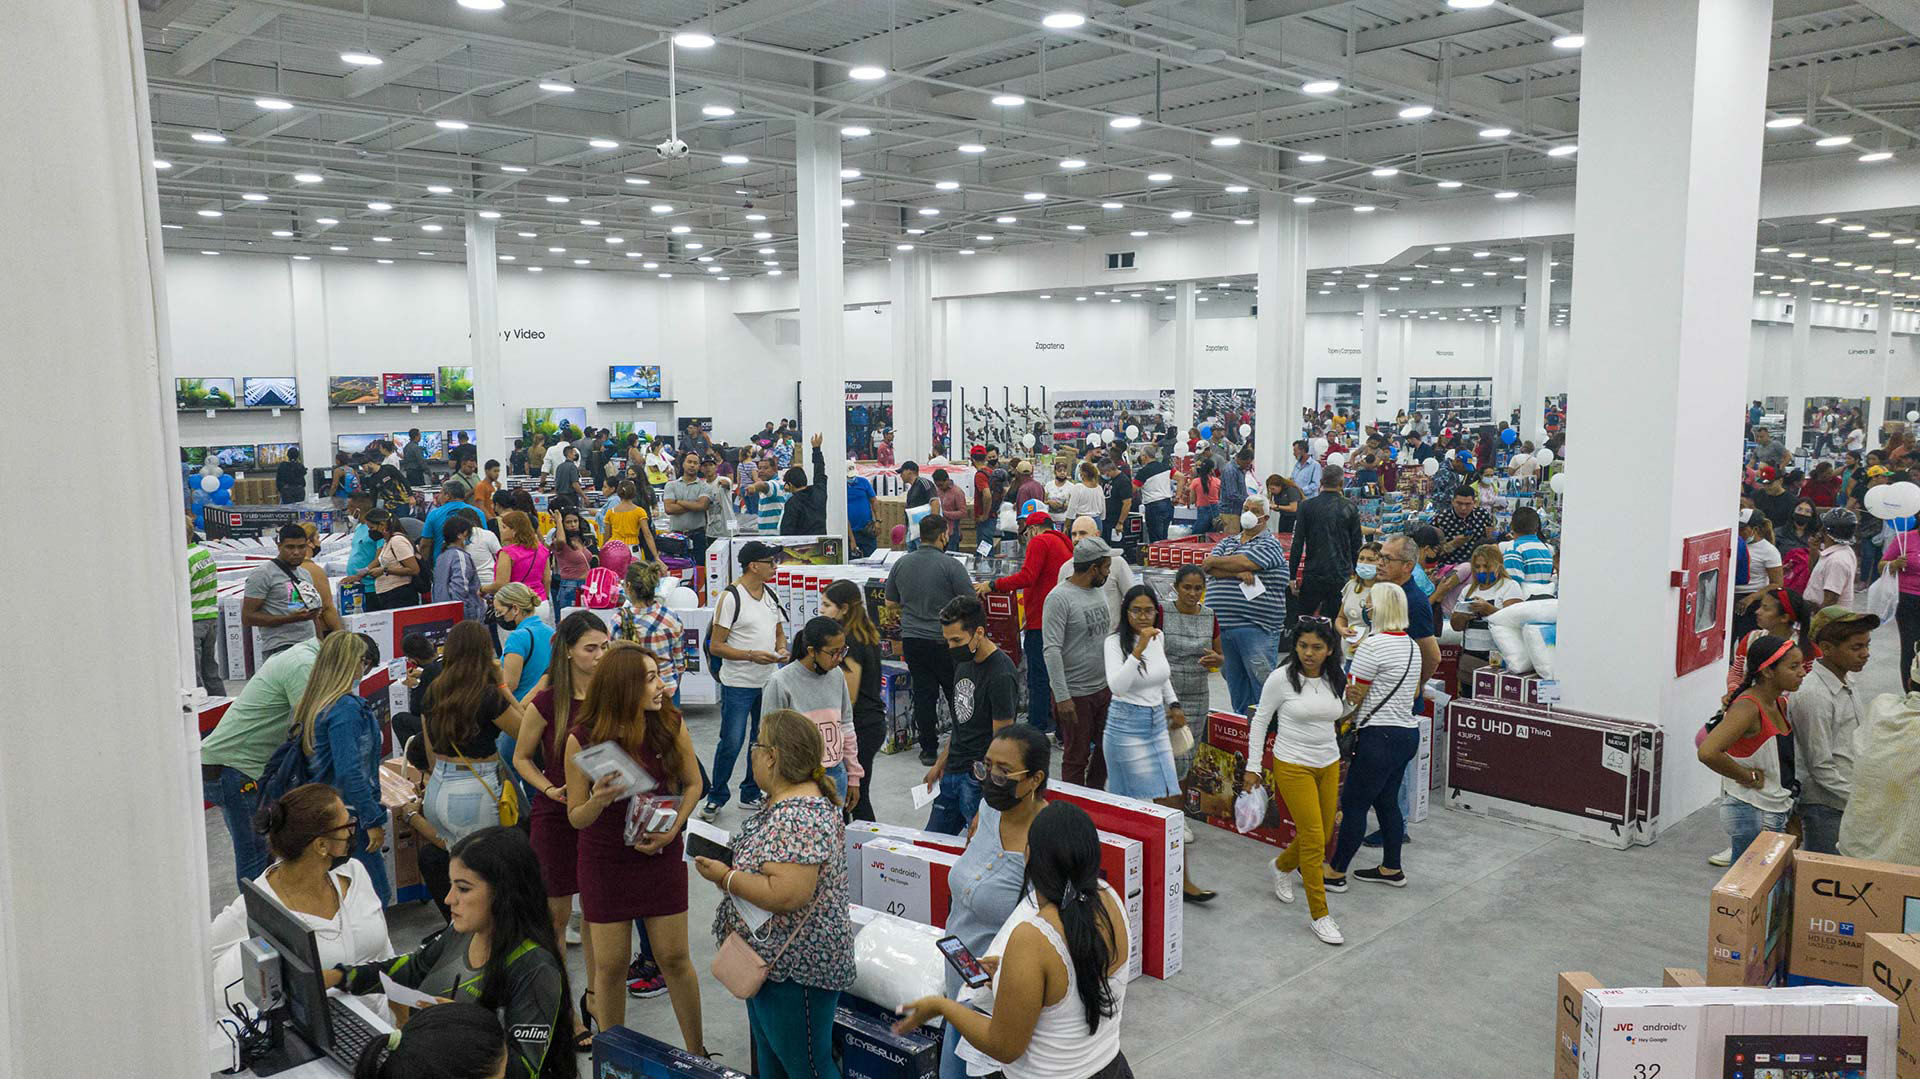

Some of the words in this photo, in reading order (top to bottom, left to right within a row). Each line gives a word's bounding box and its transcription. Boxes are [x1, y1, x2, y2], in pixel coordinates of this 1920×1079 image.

[504, 330, 511, 341] y
[513, 328, 546, 339] Video
[1699, 553, 1709, 564] FIRE
[1709, 550, 1721, 561] HOSE
[1083, 605, 1110, 625] NEW
[1214, 723, 1223, 733] TV
[1223, 727, 1238, 737] LED
[1457, 713, 1477, 729] LG
[1481, 718, 1513, 735] UHD
[1517, 726, 1528, 738] AI
[1530, 726, 1552, 738] ThinQ
[1608, 738, 1627, 747] NUEVO
[1607, 750, 1624, 765] 43
[852, 842, 862, 850] JV
[871, 861, 885, 870] JVC
[890, 866, 921, 880] androidtv
[1169, 882, 1180, 897] 50
[1811, 878, 1878, 918] CLX
[886, 900, 906, 917] 42
[1129, 902, 1139, 913] 42
[1810, 917, 1837, 933] HD
[1713, 946, 1730, 958] HD
[1873, 960, 1917, 1024] CLX
[1563, 995, 1581, 1028] CL
[513, 1027, 550, 1039] online
[1613, 1023, 1634, 1032] JVC
[1642, 1022, 1687, 1031] androidtv
[853, 1036, 905, 1066] CYBERLUX
[1633, 1063, 1661, 1079] 32
